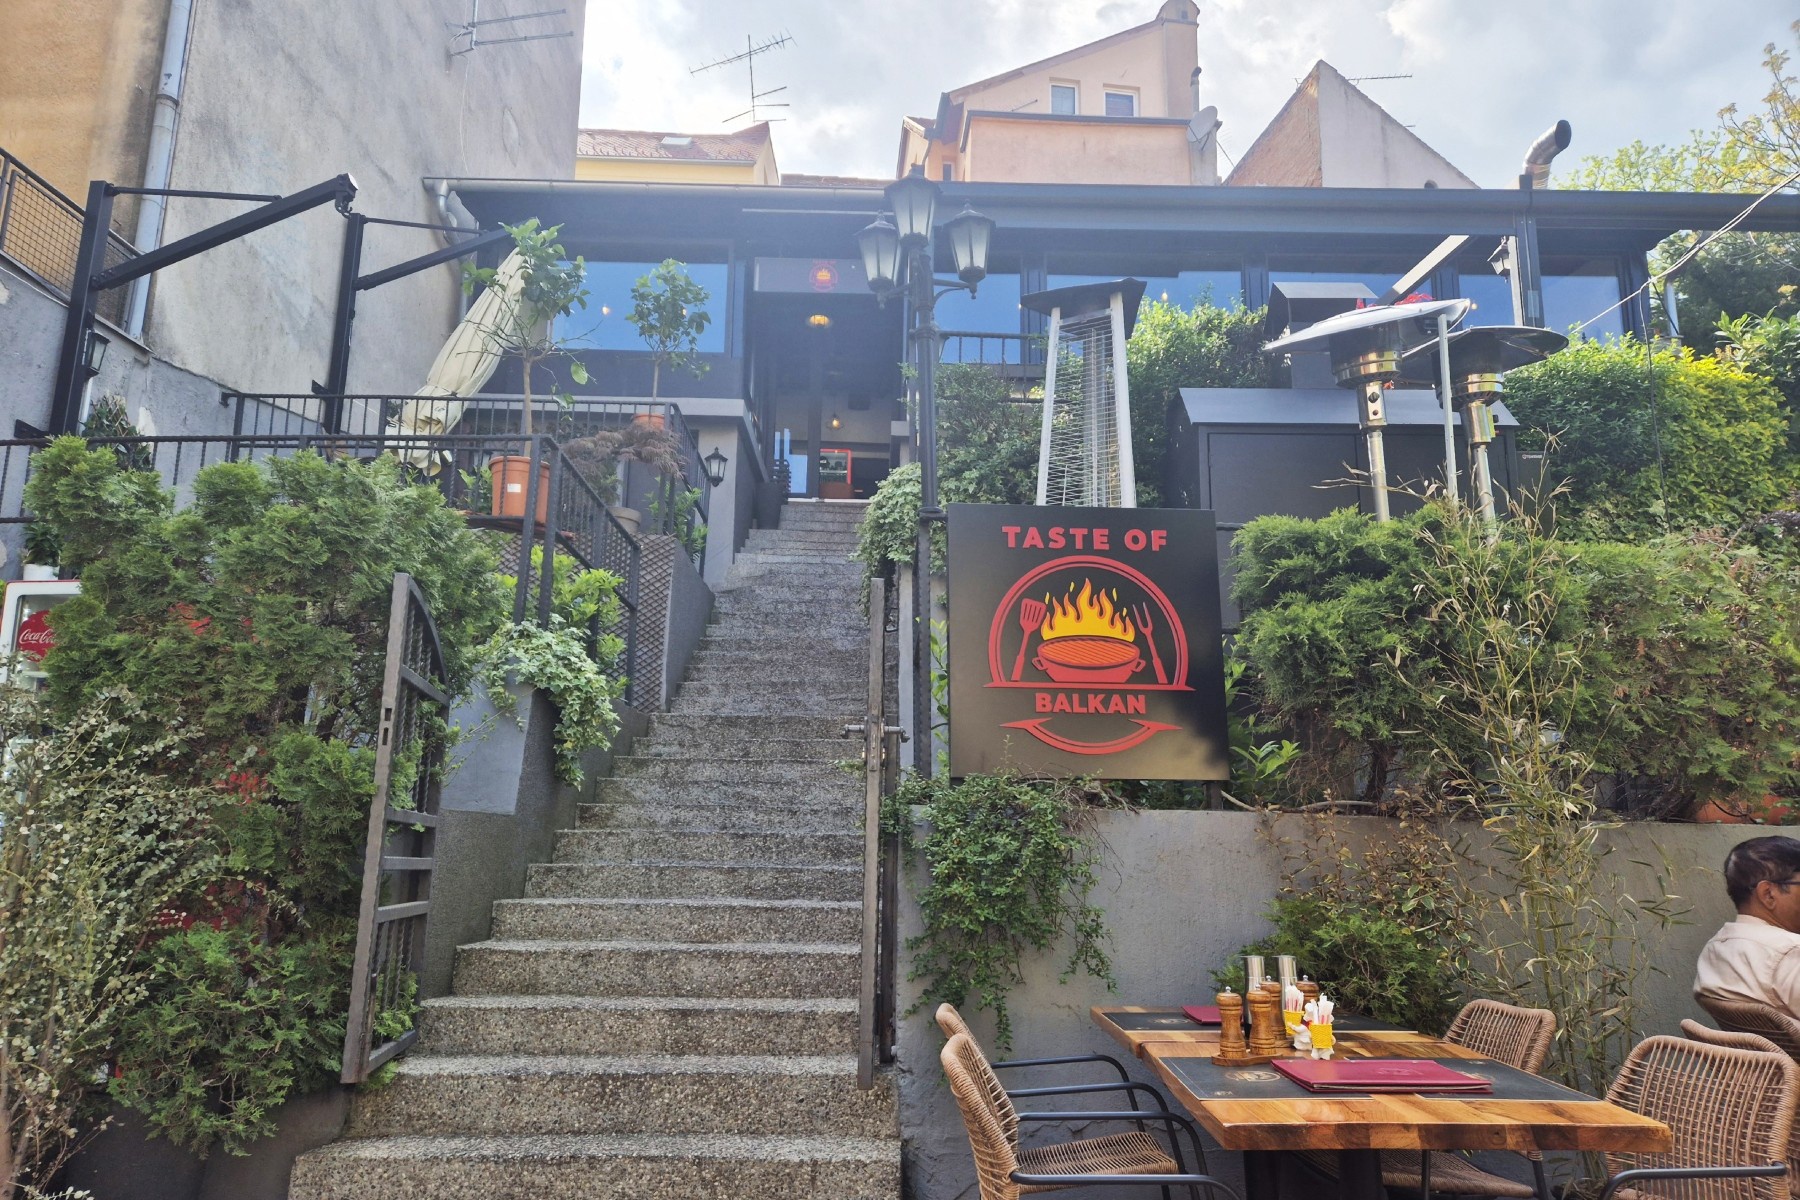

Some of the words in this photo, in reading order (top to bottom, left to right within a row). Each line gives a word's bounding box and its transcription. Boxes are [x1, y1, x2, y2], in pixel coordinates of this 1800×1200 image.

[1002, 526, 1110, 550] TASTE
[1124, 529, 1168, 551] OF
[19, 628, 56, 644] Coca-Co
[1035, 693, 1147, 715] BALKAN
